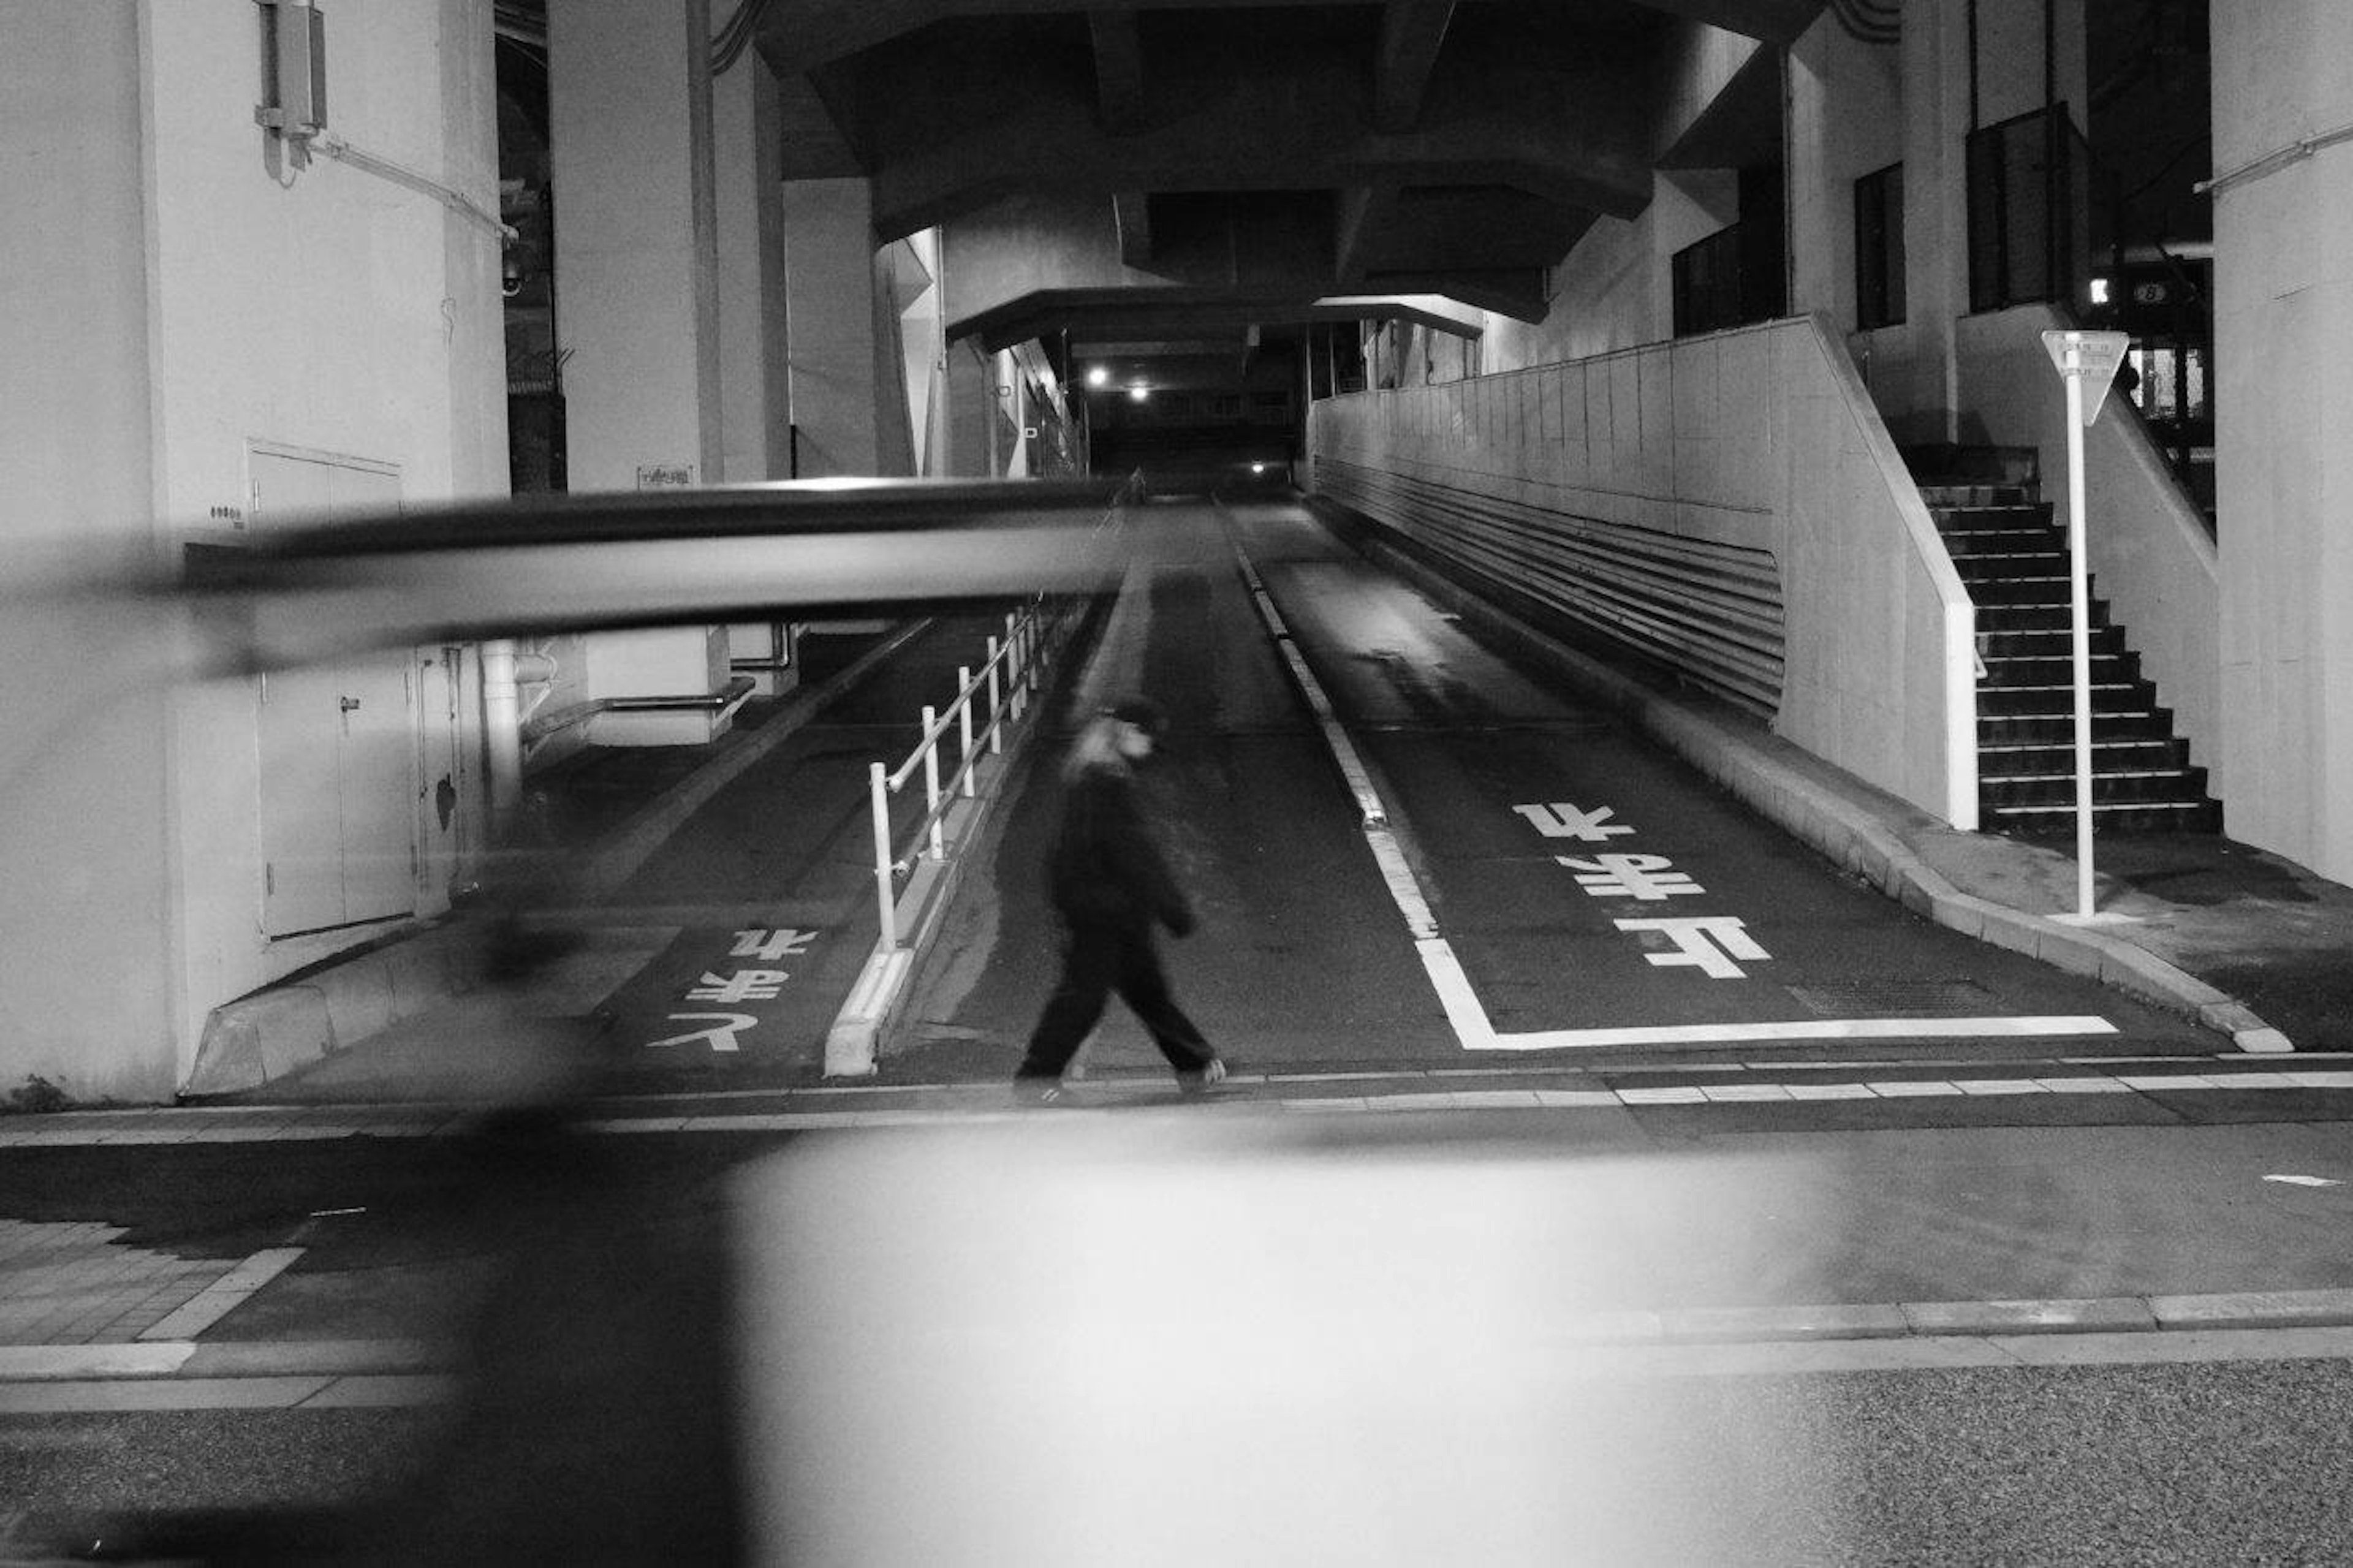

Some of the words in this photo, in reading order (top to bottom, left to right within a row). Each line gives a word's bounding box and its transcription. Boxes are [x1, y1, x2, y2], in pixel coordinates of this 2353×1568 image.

[1512, 803, 1773, 979] 止まれ
[646, 929, 819, 1051] とまれ
